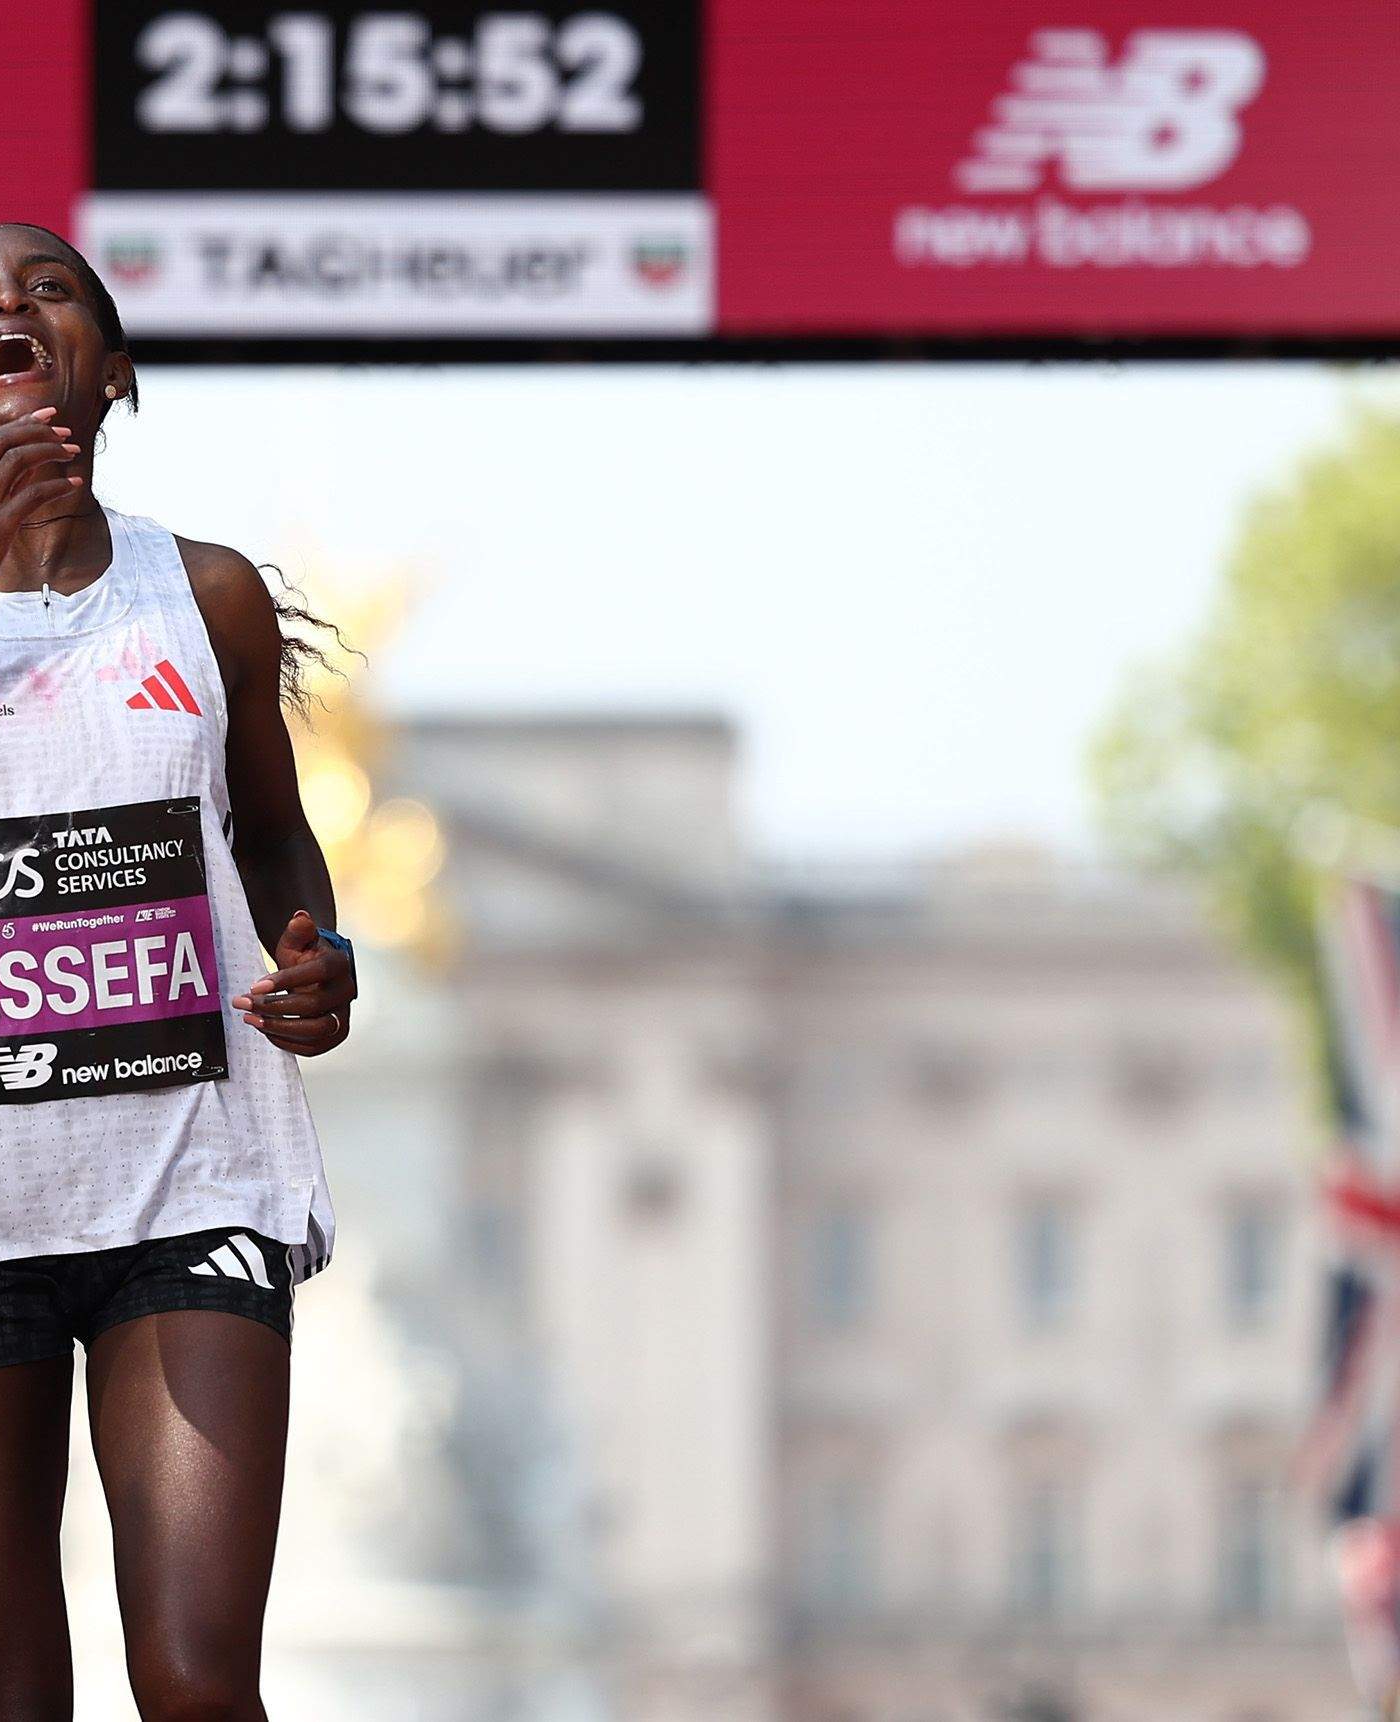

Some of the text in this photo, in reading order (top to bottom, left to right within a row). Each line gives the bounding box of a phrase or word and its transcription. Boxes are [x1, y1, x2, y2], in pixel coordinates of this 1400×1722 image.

[136, 11, 644, 134] 2:15:52
[894, 195, 1311, 268] new balance
[52, 826, 113, 849] TATA
[55, 839, 184, 872] CONSULTANCY
[57, 868, 147, 895] SERVICES
[32, 914, 125, 932] #WeRunTogether
[62, 1052, 203, 1084] new balance
